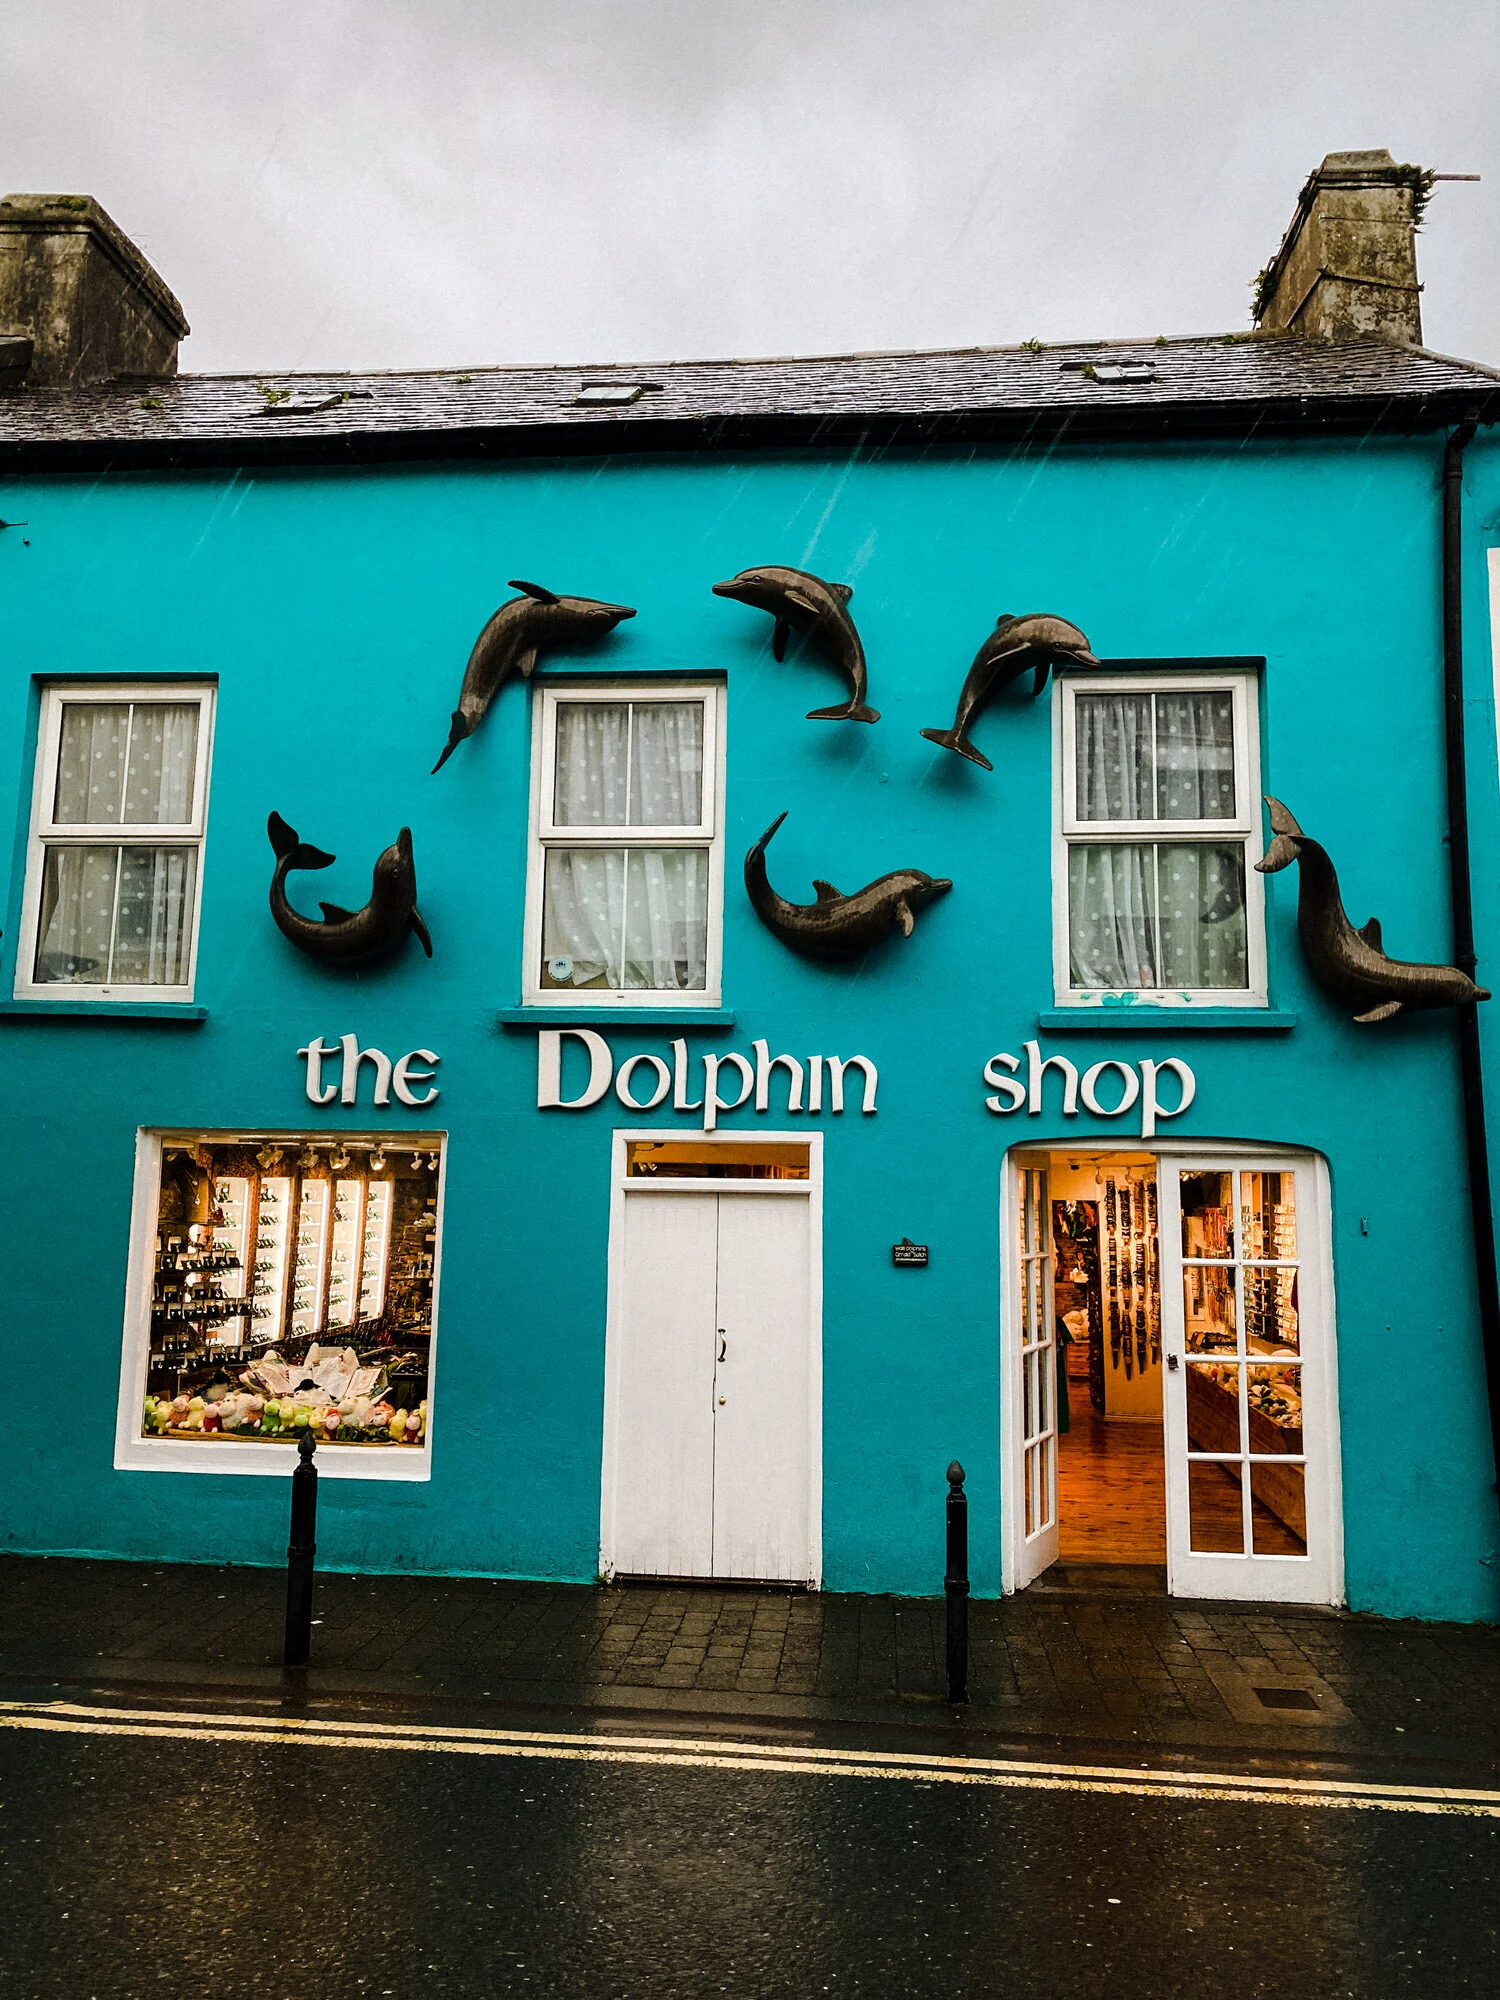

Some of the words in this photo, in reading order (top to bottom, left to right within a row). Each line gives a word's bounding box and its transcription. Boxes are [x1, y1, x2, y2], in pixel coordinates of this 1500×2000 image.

[297, 1033, 440, 1105] the
[537, 1029, 878, 1131] Dolphin
[984, 1040, 1196, 1139] shop
